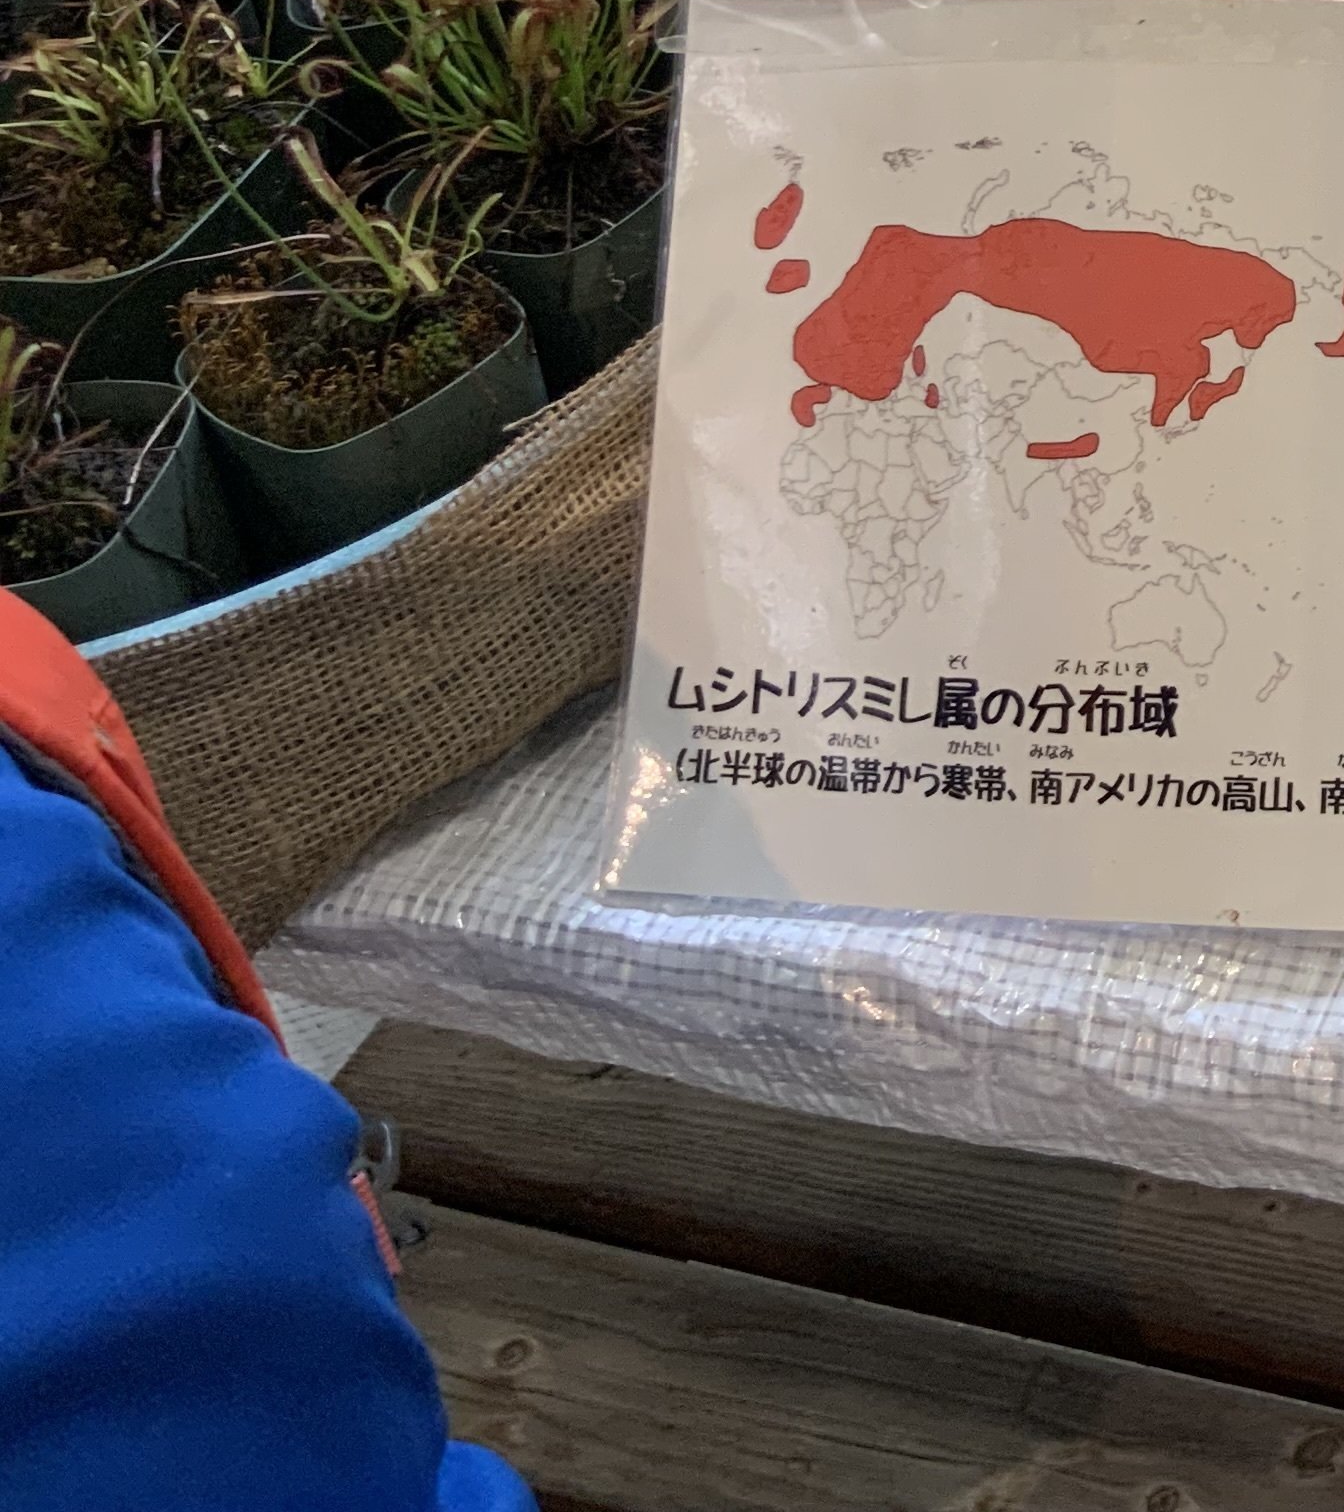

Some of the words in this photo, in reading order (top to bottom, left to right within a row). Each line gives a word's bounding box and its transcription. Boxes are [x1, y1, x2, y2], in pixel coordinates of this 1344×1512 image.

[668, 666, 1179, 738] ムシトリスミレ属の分布域
[947, 740, 1001, 757] かんたい
[1029, 744, 1074, 760] みなみ
